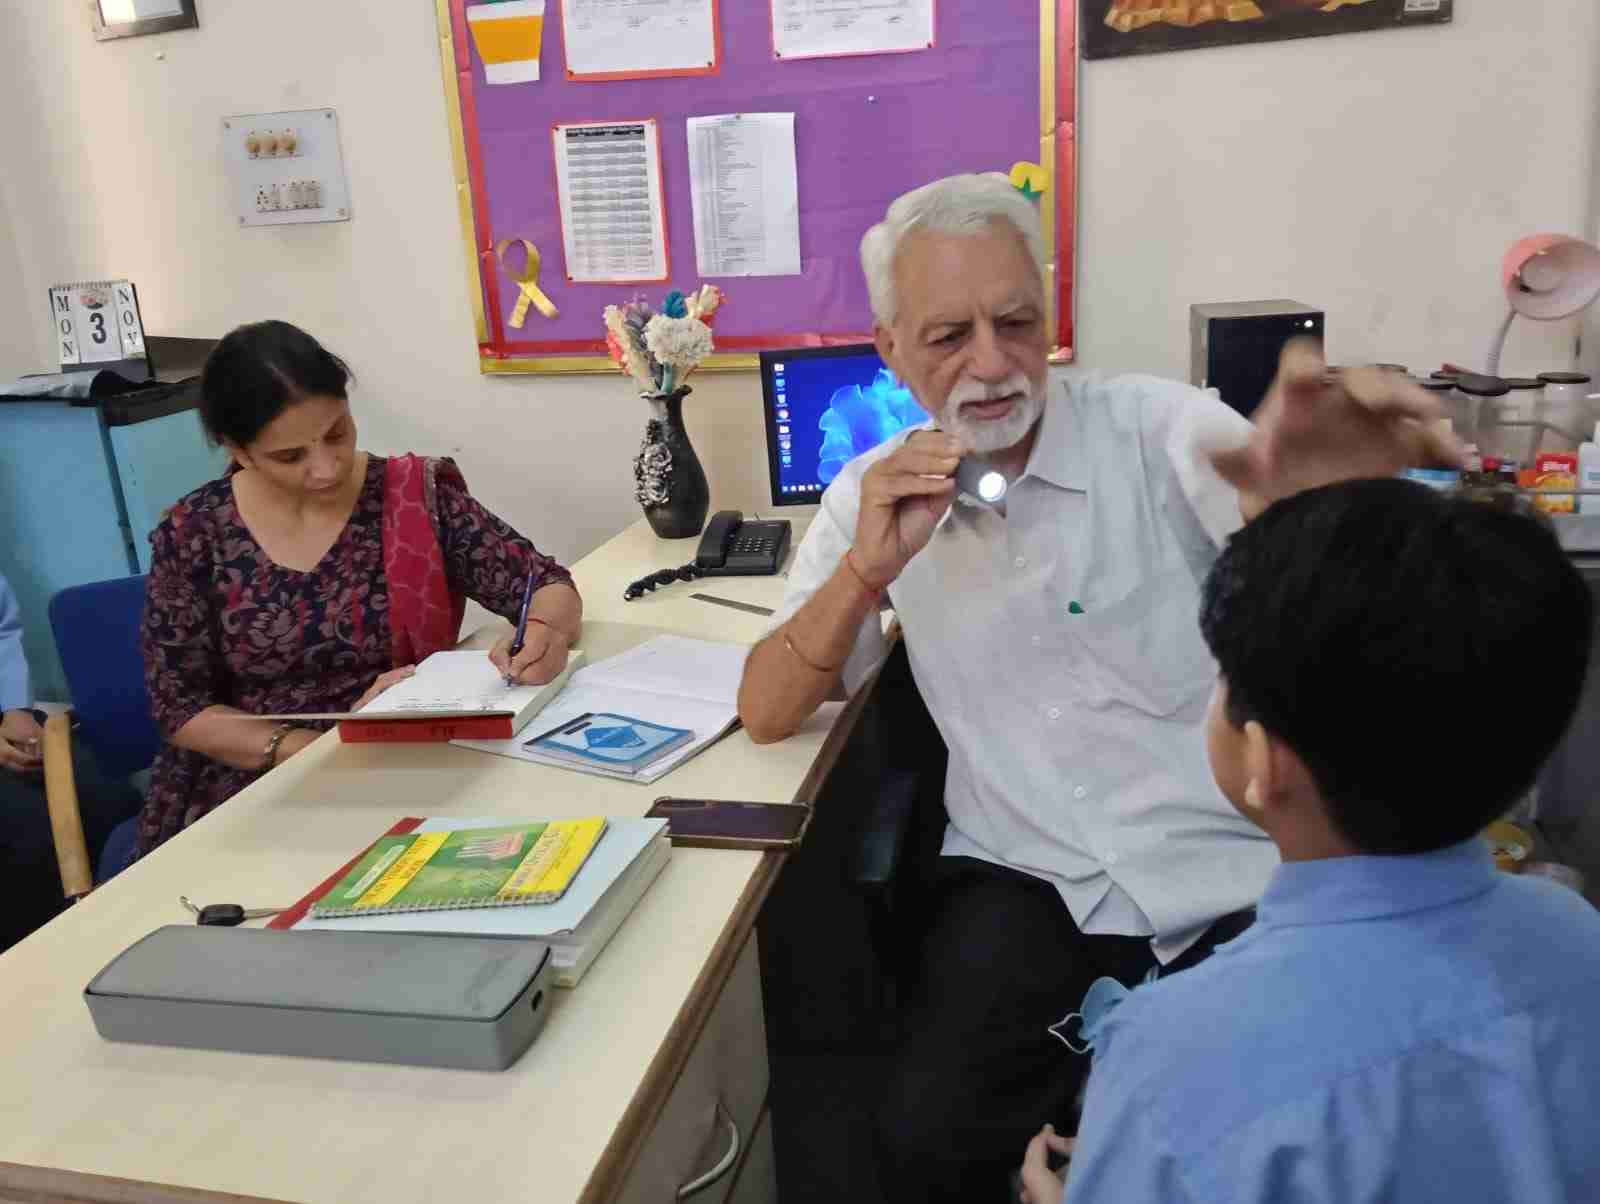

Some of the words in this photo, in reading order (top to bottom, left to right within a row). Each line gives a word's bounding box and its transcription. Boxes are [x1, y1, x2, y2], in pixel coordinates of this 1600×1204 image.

[56, 295, 74, 357] MON
[89, 312, 107, 344] 3
[118, 287, 137, 345] NOV
